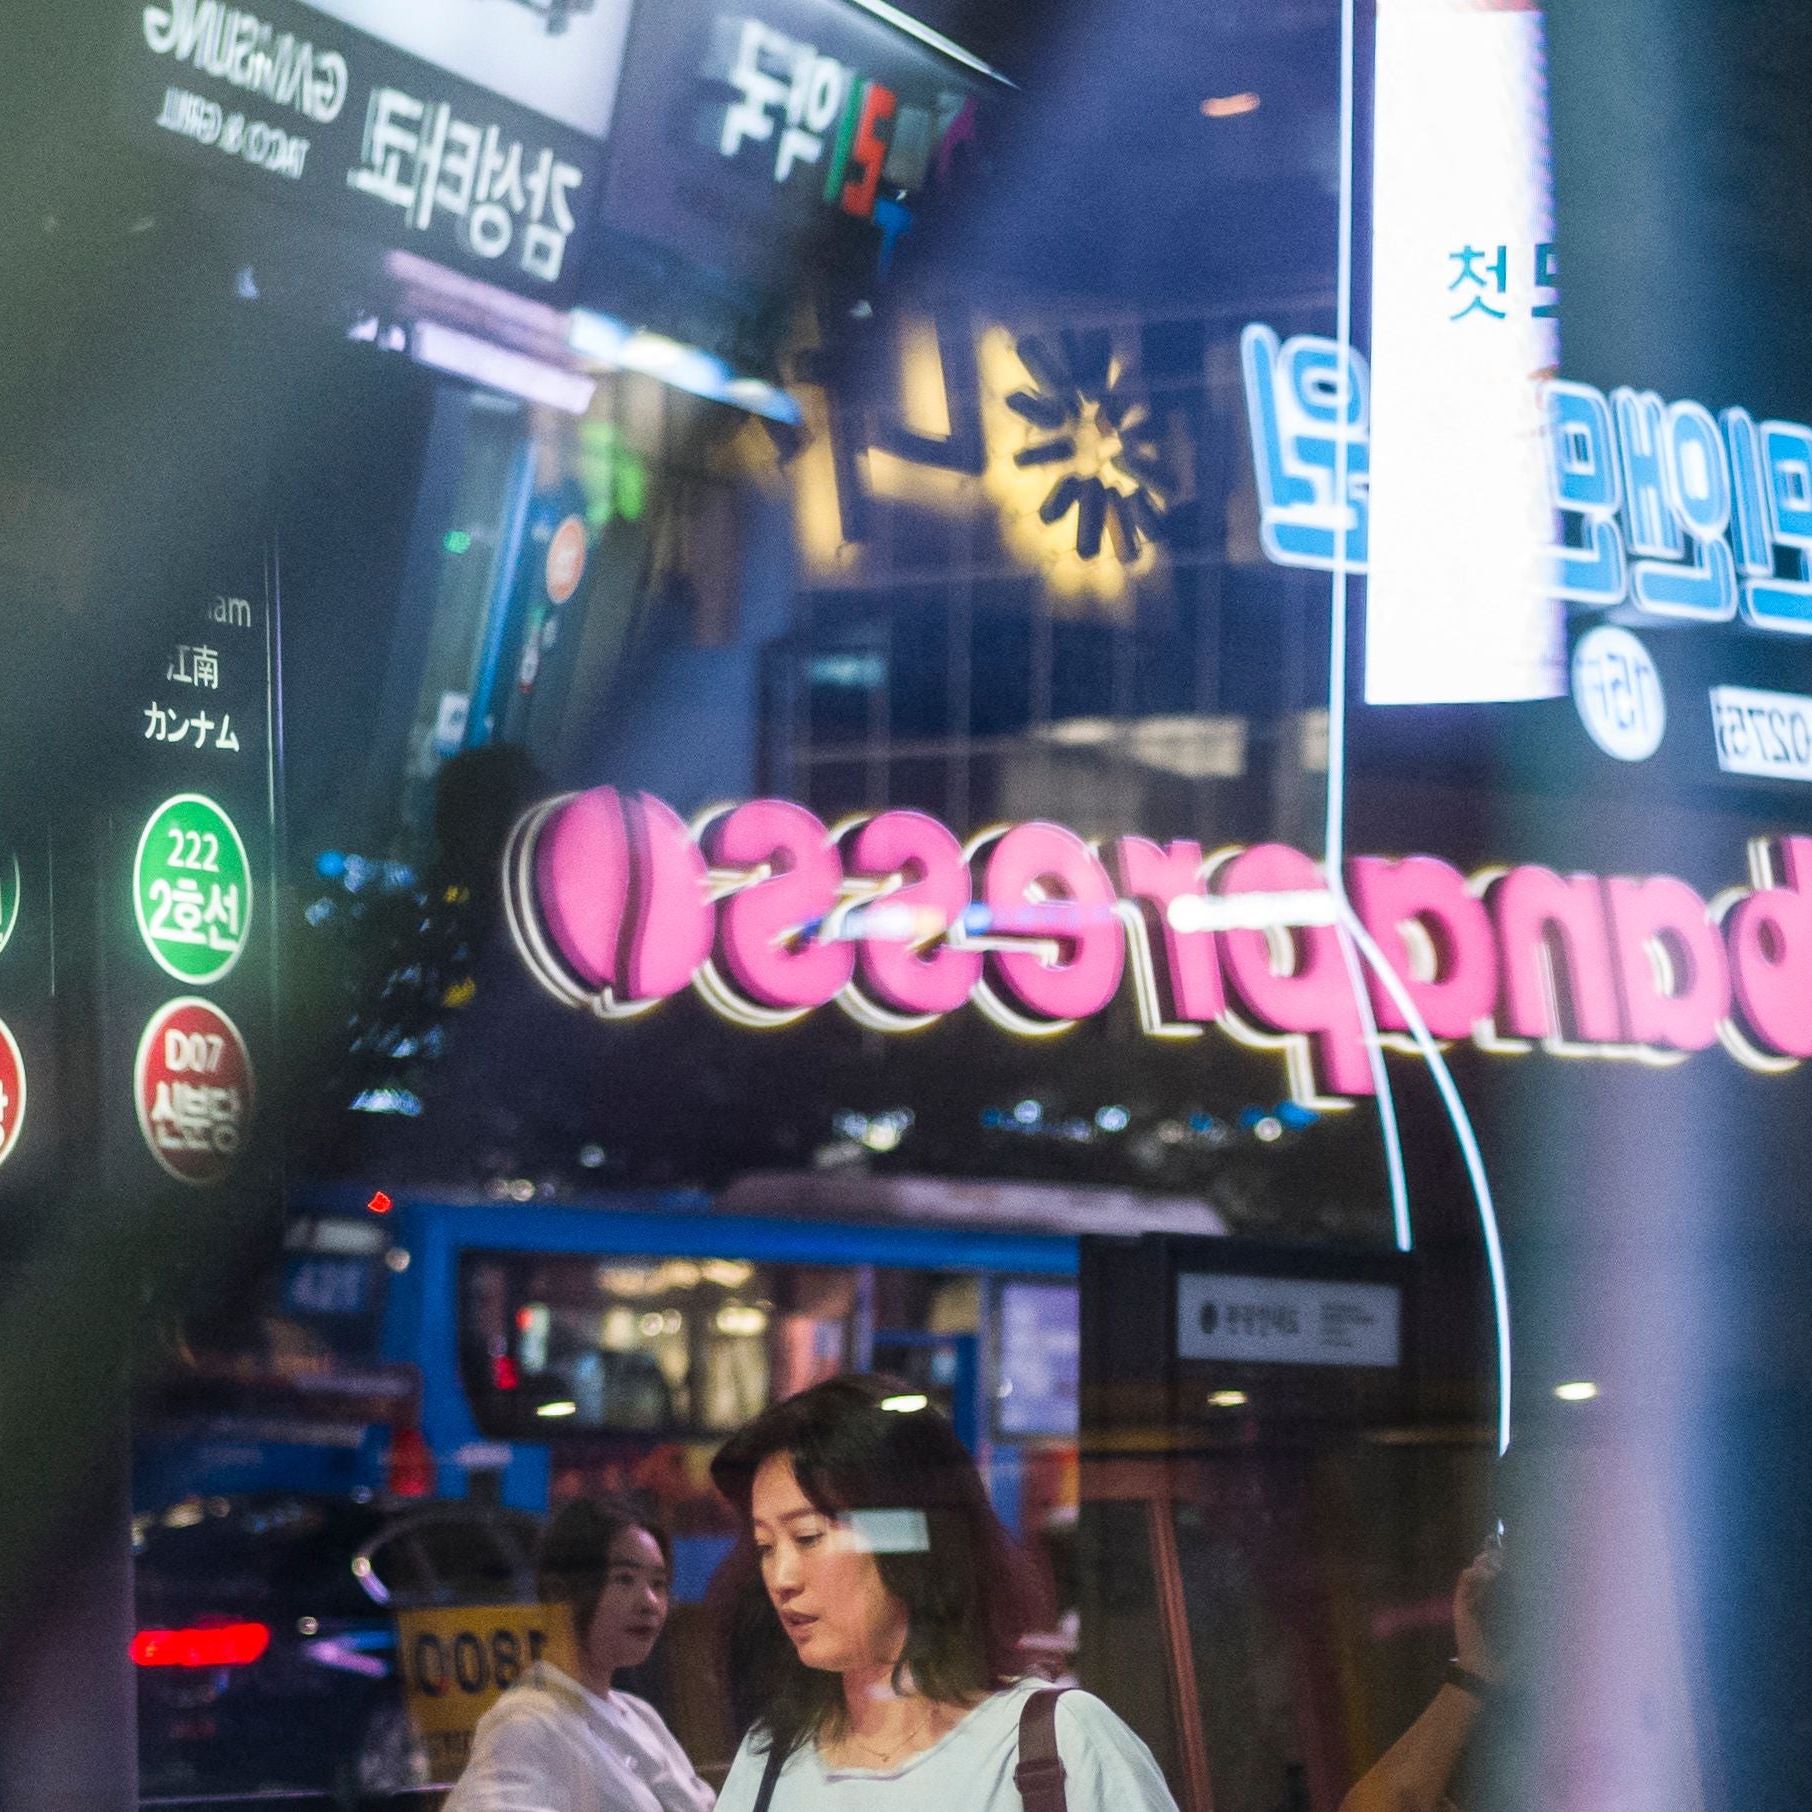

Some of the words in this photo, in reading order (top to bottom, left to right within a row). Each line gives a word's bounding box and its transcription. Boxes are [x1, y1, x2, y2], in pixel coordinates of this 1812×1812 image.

[1447, 244, 1507, 321] 첫
[206, 594, 252, 628] am
[166, 644, 219, 690] 江南
[144, 701, 240, 752] カンナム
[166, 829, 219, 873] 222
[149, 879, 240, 952] 2호선
[164, 1029, 224, 1074] D07
